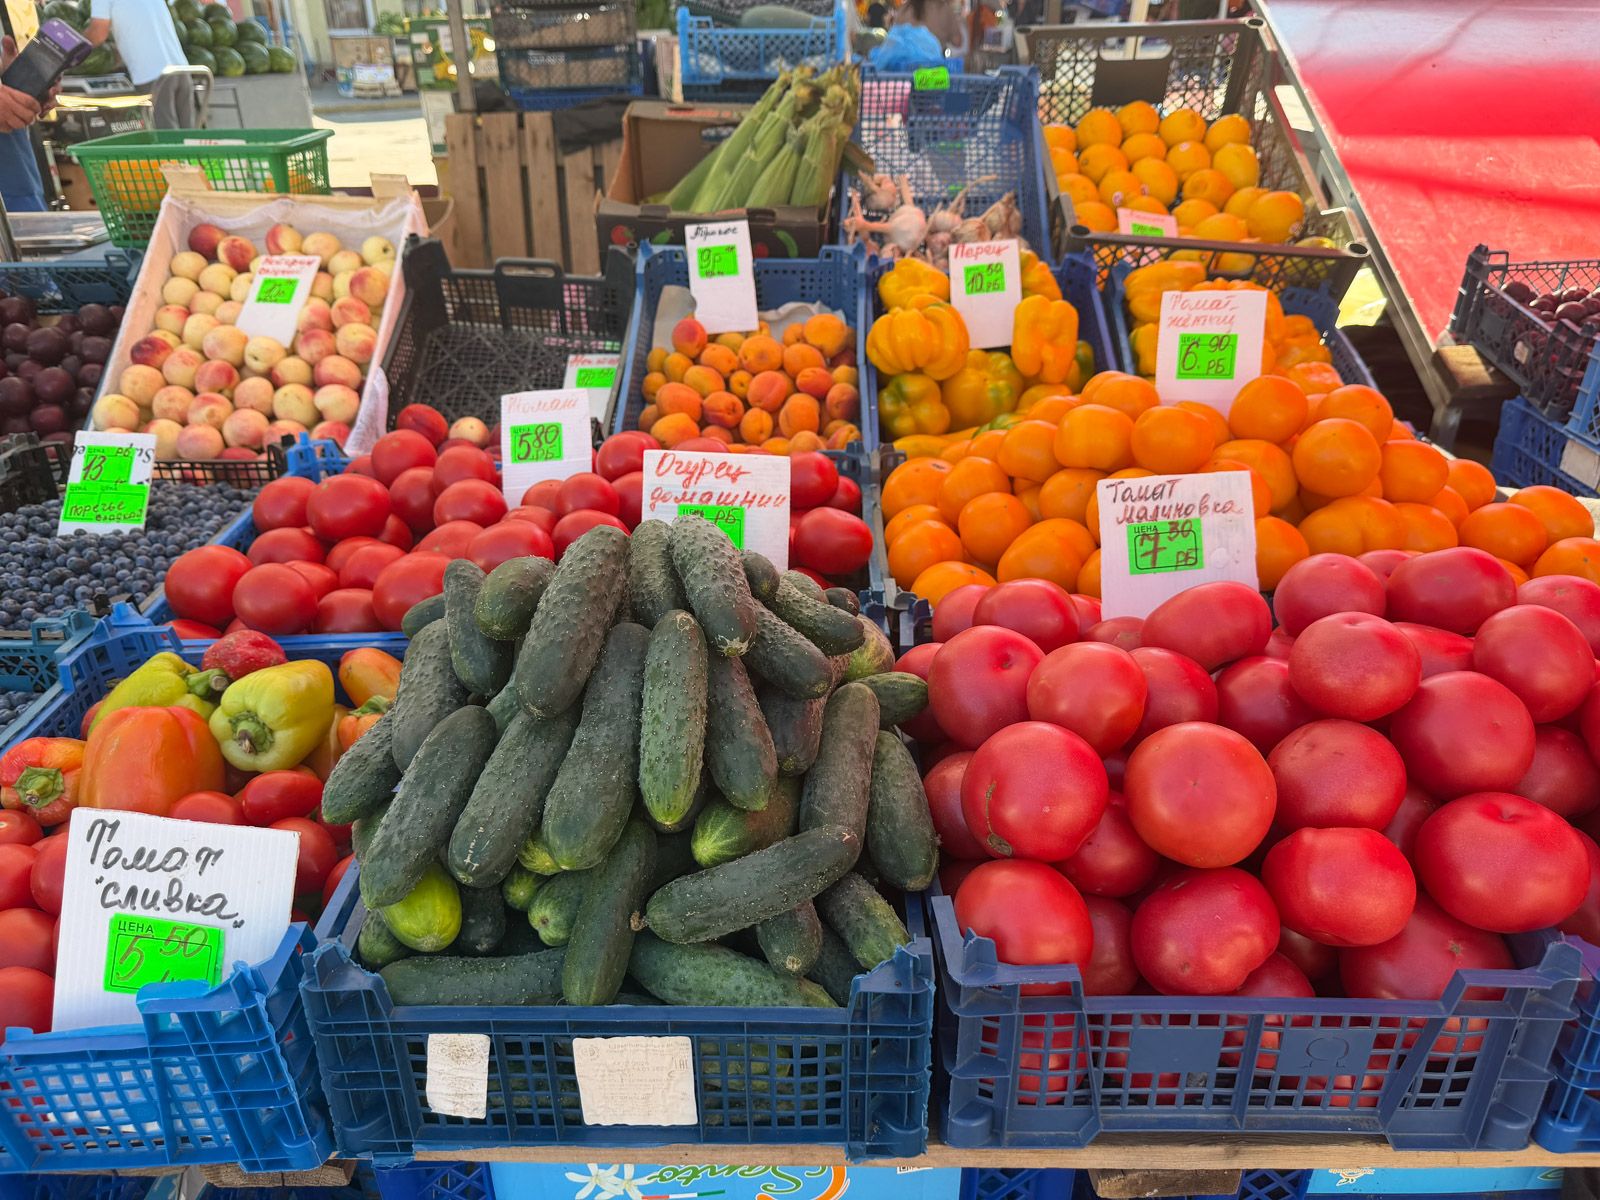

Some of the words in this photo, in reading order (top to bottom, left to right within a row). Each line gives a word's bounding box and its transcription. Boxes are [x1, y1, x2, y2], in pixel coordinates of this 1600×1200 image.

[82, 454, 107, 481] 13
[655, 452, 752, 489] Огурец
[86, 818, 225, 876] Томат
[118, 920, 155, 933] ЦЕНА
[116, 934, 153, 982] 5
[159, 926, 209, 958] 50
